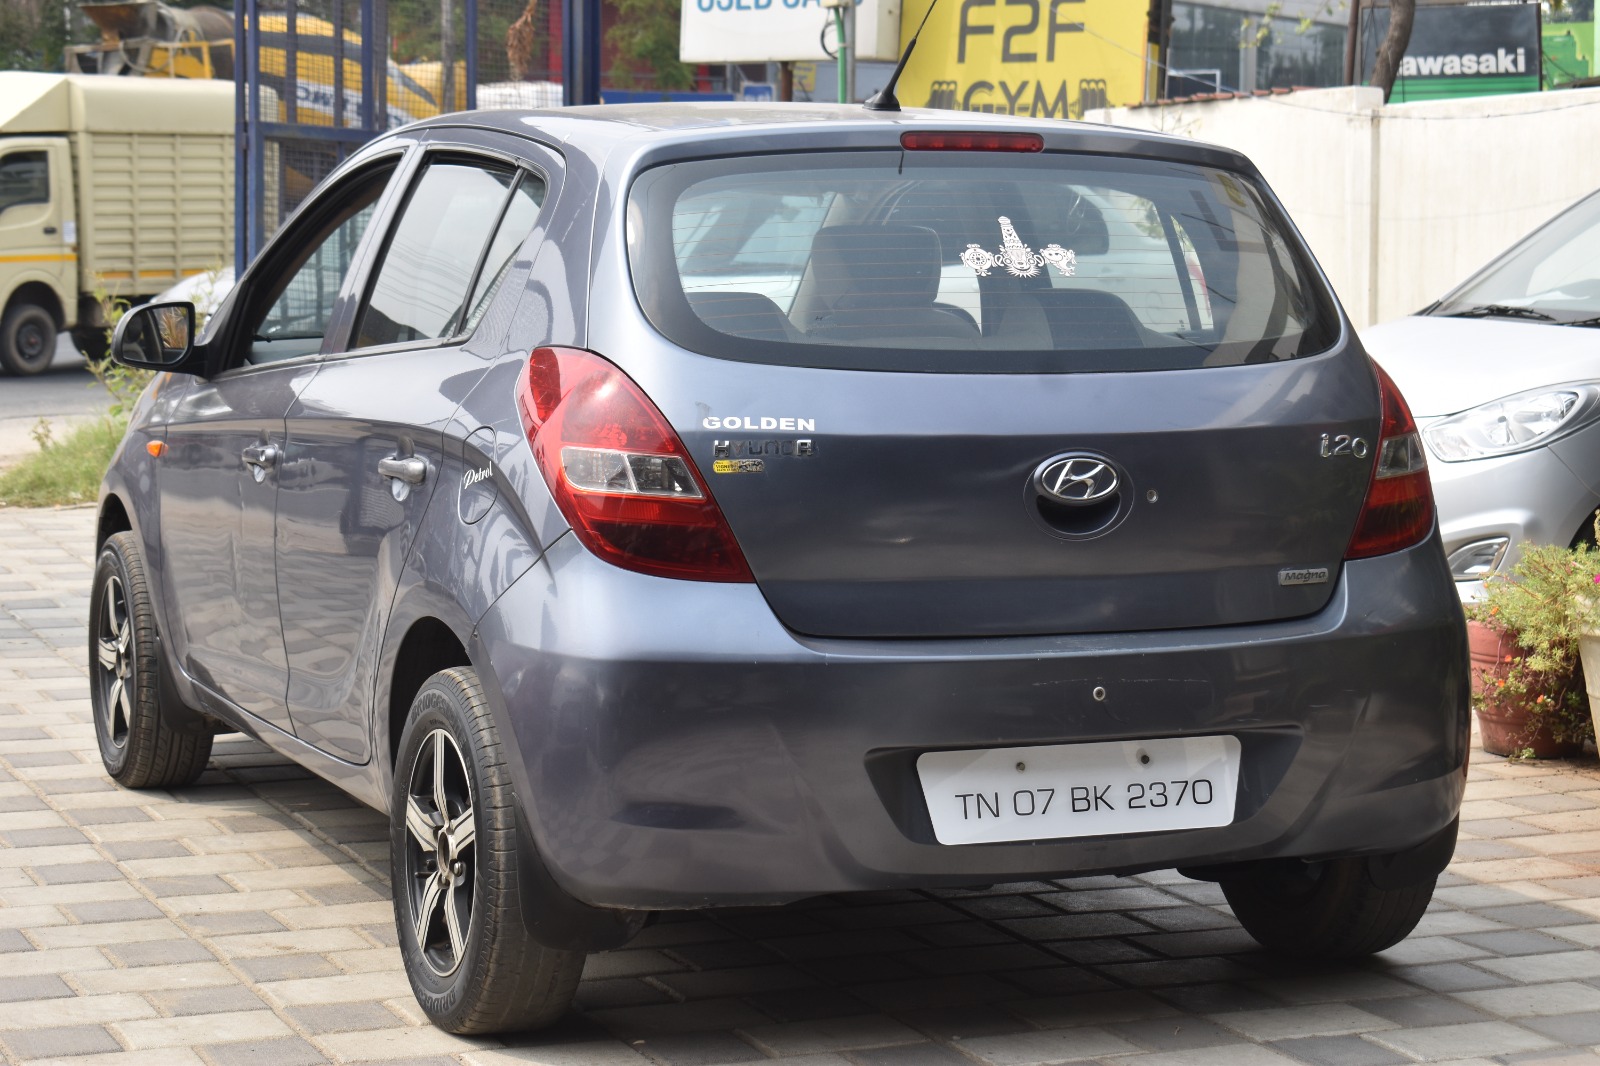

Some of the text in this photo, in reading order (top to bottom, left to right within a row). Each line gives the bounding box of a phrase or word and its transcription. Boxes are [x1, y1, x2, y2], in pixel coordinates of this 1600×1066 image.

[957, 0, 1086, 63] F2F
[1396, 48, 1526, 76] awasaki
[702, 416, 815, 431] GOLDEN
[1320, 433, 1368, 458] i20
[1285, 570, 1326, 583] Magna
[955, 779, 1213, 820] TN 07 BK 2370
